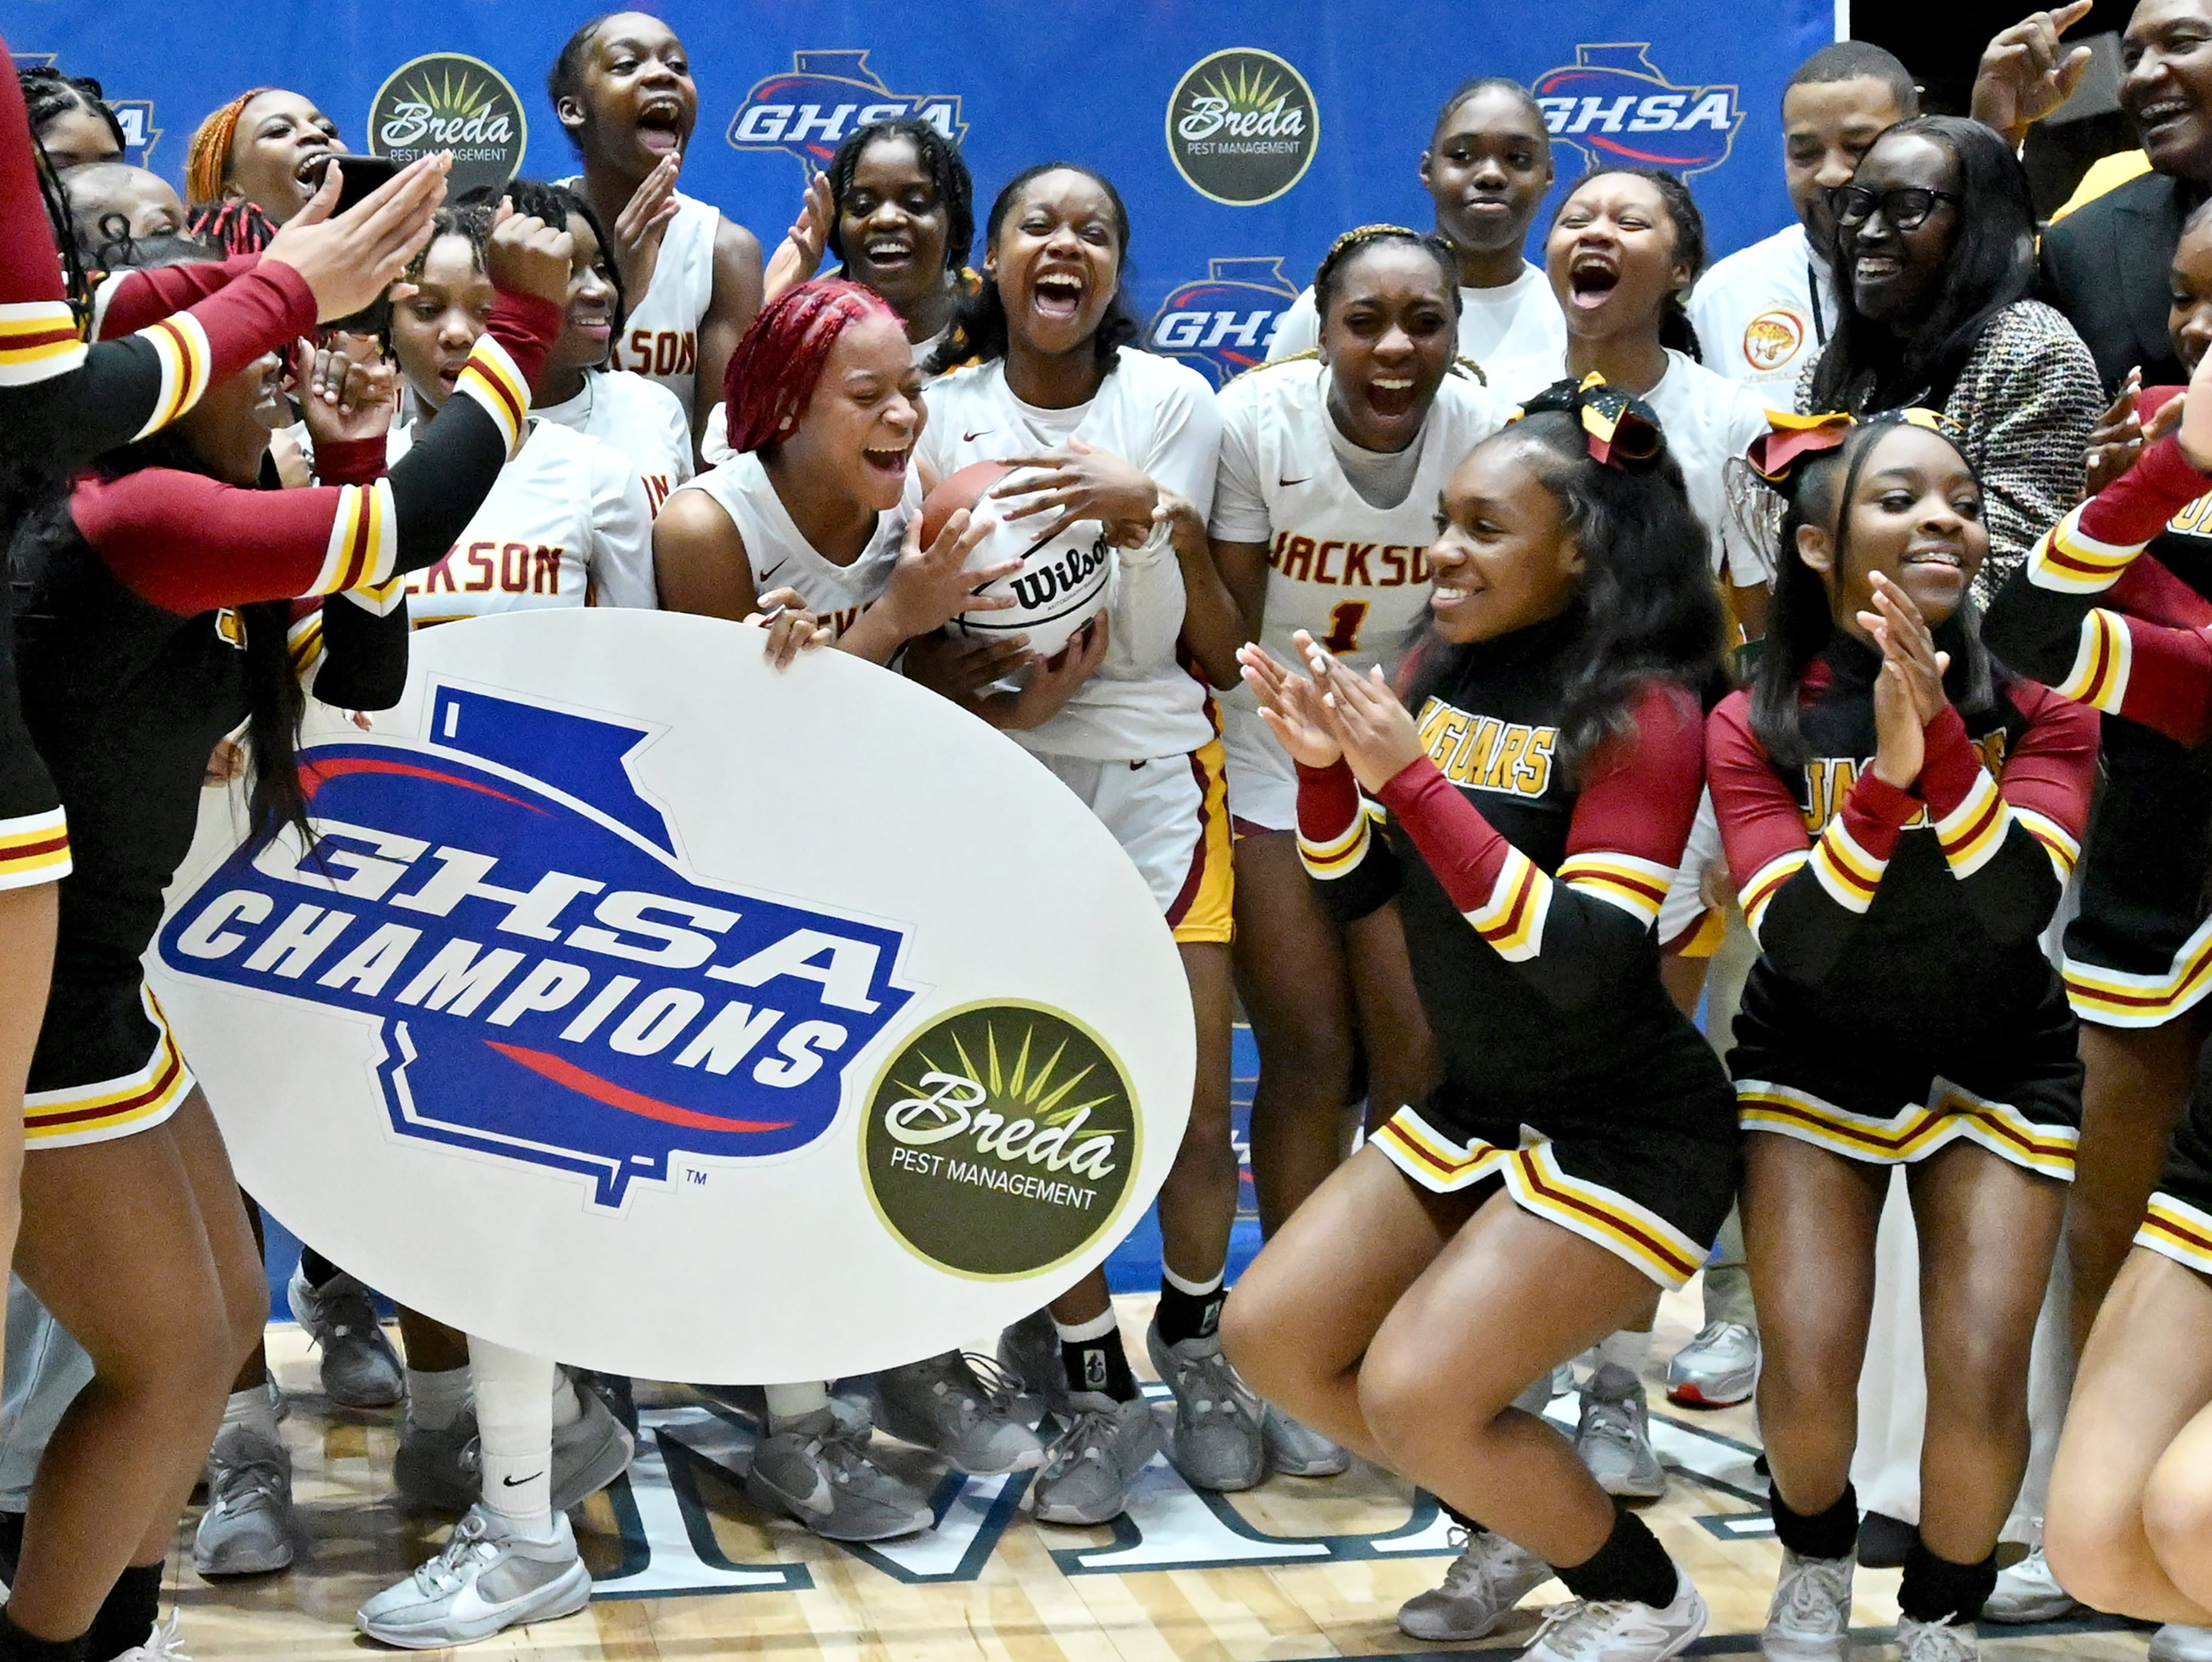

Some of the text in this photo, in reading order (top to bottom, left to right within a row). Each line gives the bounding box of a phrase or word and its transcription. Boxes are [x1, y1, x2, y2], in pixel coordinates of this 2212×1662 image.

[381, 102, 514, 147] Breda
[1178, 97, 1306, 141] Breda
[1535, 93, 1732, 133] GHSA
[390, 149, 420, 161] PEST
[1187, 141, 1300, 155] PEST MANAGEMENT
[1153, 310, 1290, 347] GH
[405, 541, 564, 595] KSON
[1009, 534, 1109, 609] Wilso
[1267, 530, 1433, 586] JACKSO
[1322, 599, 1370, 656] 1
[252, 817, 881, 1015] GHSA
[177, 889, 848, 1088] CHAMPIONS
[884, 1071, 1116, 1181] Breda
[685, 1170, 707, 1186] TM
[890, 1147, 1097, 1210] PEST MANAGEMENT
